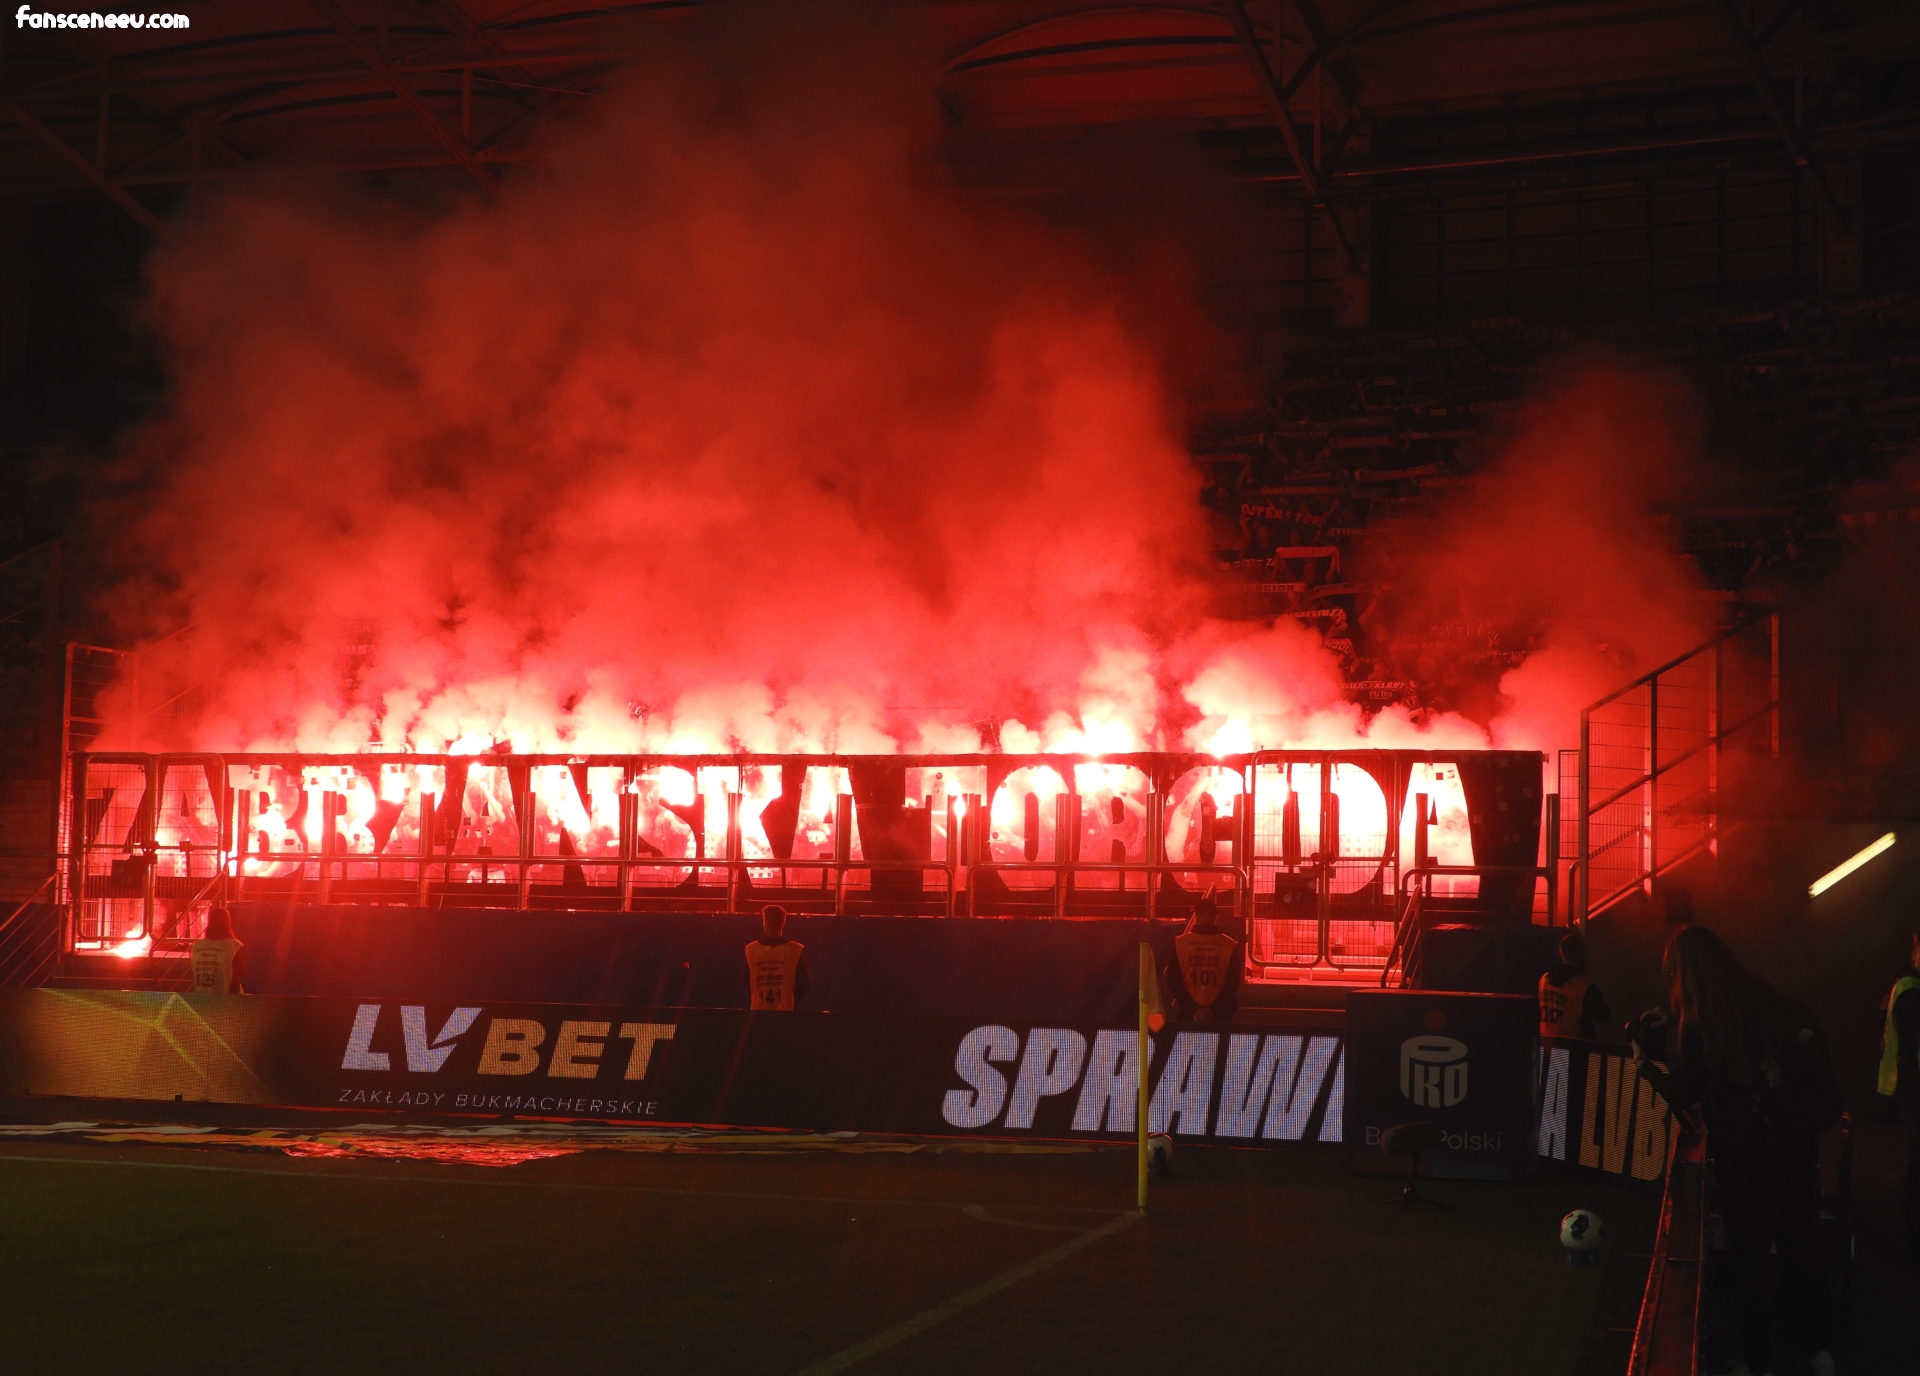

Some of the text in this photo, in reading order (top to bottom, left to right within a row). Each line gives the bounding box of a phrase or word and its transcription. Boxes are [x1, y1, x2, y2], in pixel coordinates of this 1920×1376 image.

[904, 760, 1481, 899] TORCIDA
[759, 989, 782, 1005] 141
[339, 1089, 659, 1116] ZAKŁADY BUKMACHERSKIE
[942, 1025, 1344, 1142] SPRAW
[1400, 1035, 1468, 1108] PKO
[1538, 1046, 1678, 1181] A LVB
